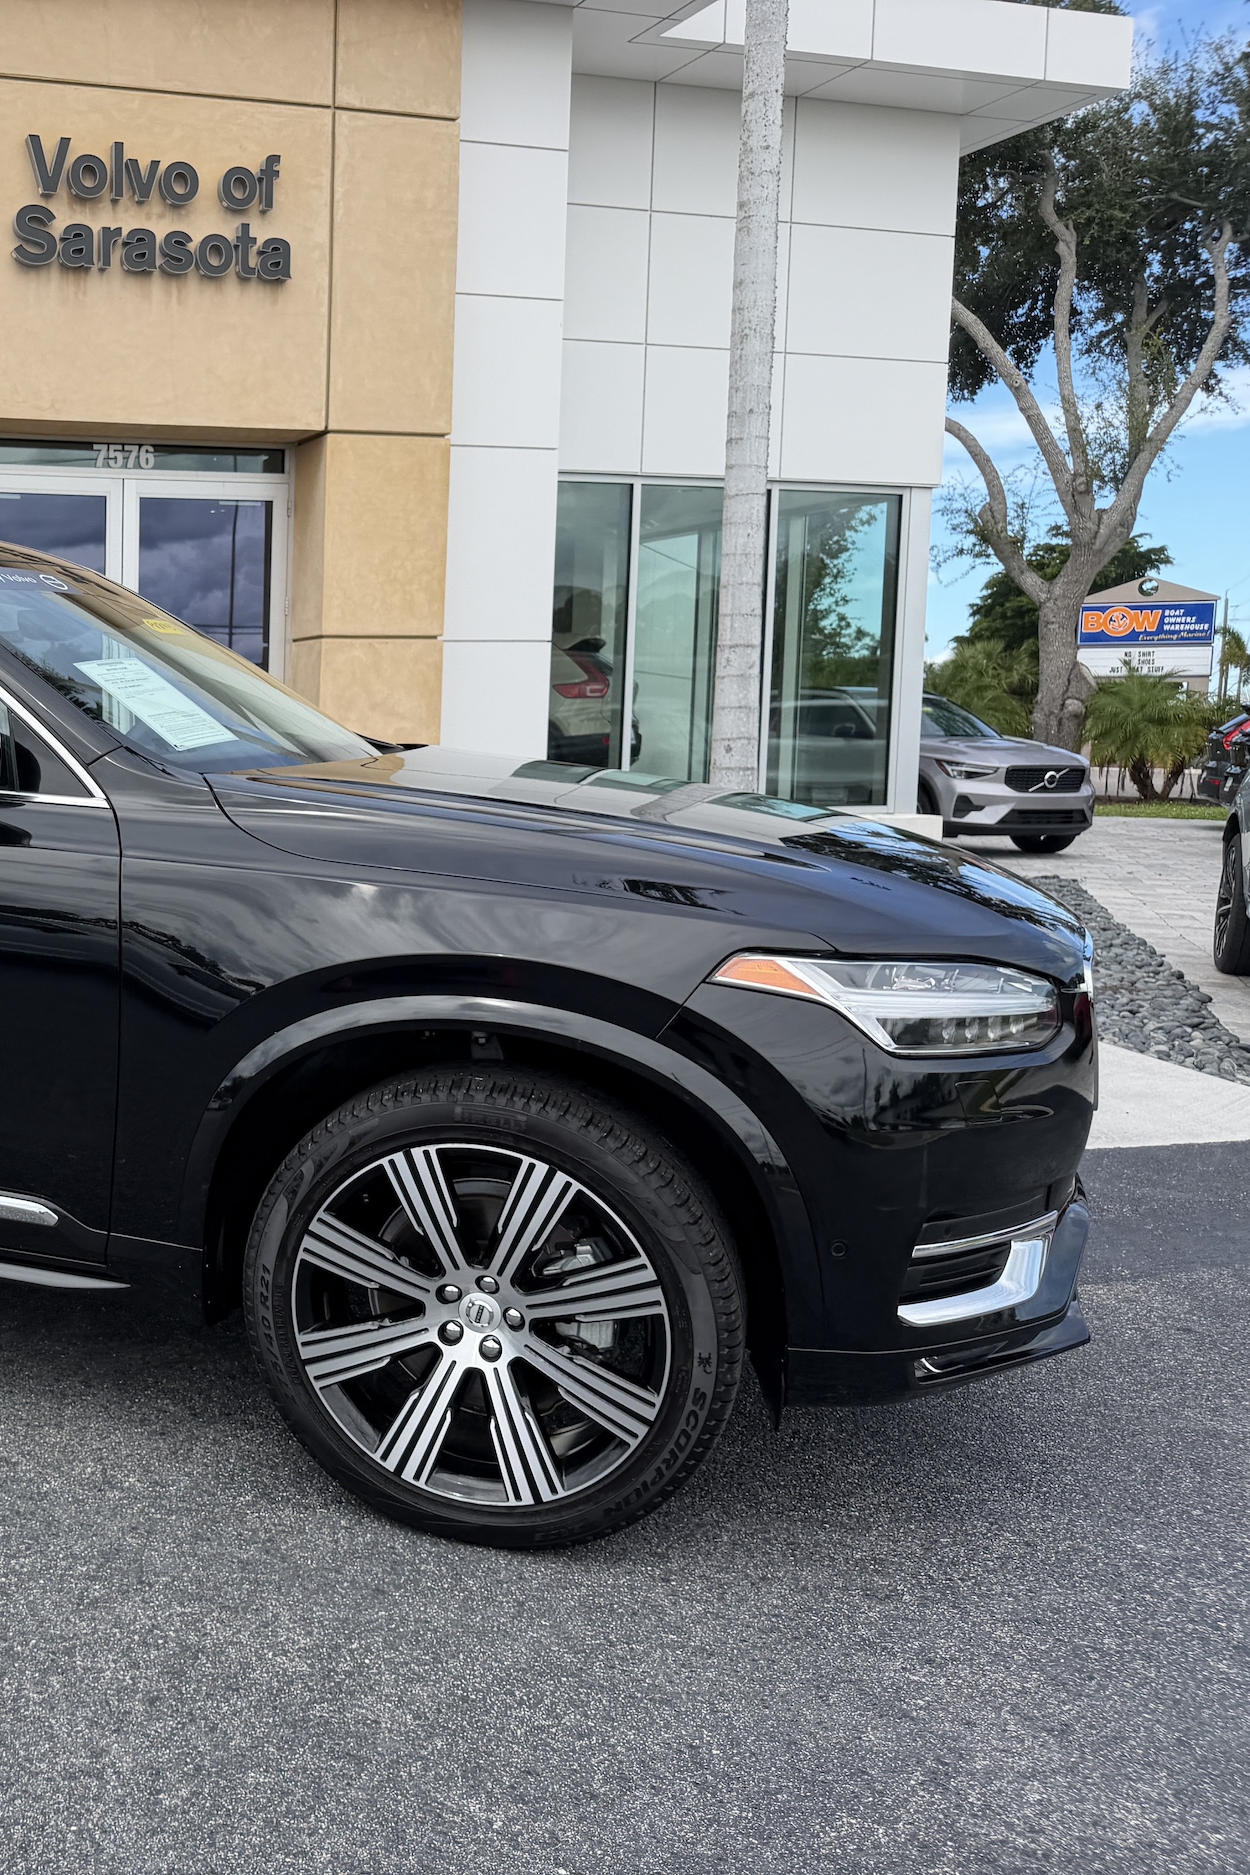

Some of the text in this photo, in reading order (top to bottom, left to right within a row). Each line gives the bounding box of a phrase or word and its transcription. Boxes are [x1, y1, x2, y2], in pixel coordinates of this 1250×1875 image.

[25, 133, 282, 212] Volvo of
[11, 203, 293, 282] Sarasota
[92, 443, 156, 470] 7576
[4, 573, 38, 585] Volvo
[1164, 609, 1185, 617] BOAT
[1082, 606, 1162, 637] BOW
[1163, 616, 1197, 624] OWNERS
[1163, 623, 1210, 631] WAREHOUSE
[1138, 632, 1178, 642] Everything
[1137, 650, 1156, 658] SHIRT
[1137, 658, 1156, 666] SHOES
[1109, 666, 1123, 674] JUST
[260, 1263, 271, 1311] R21
[603, 1387, 707, 1519] SCORPION
